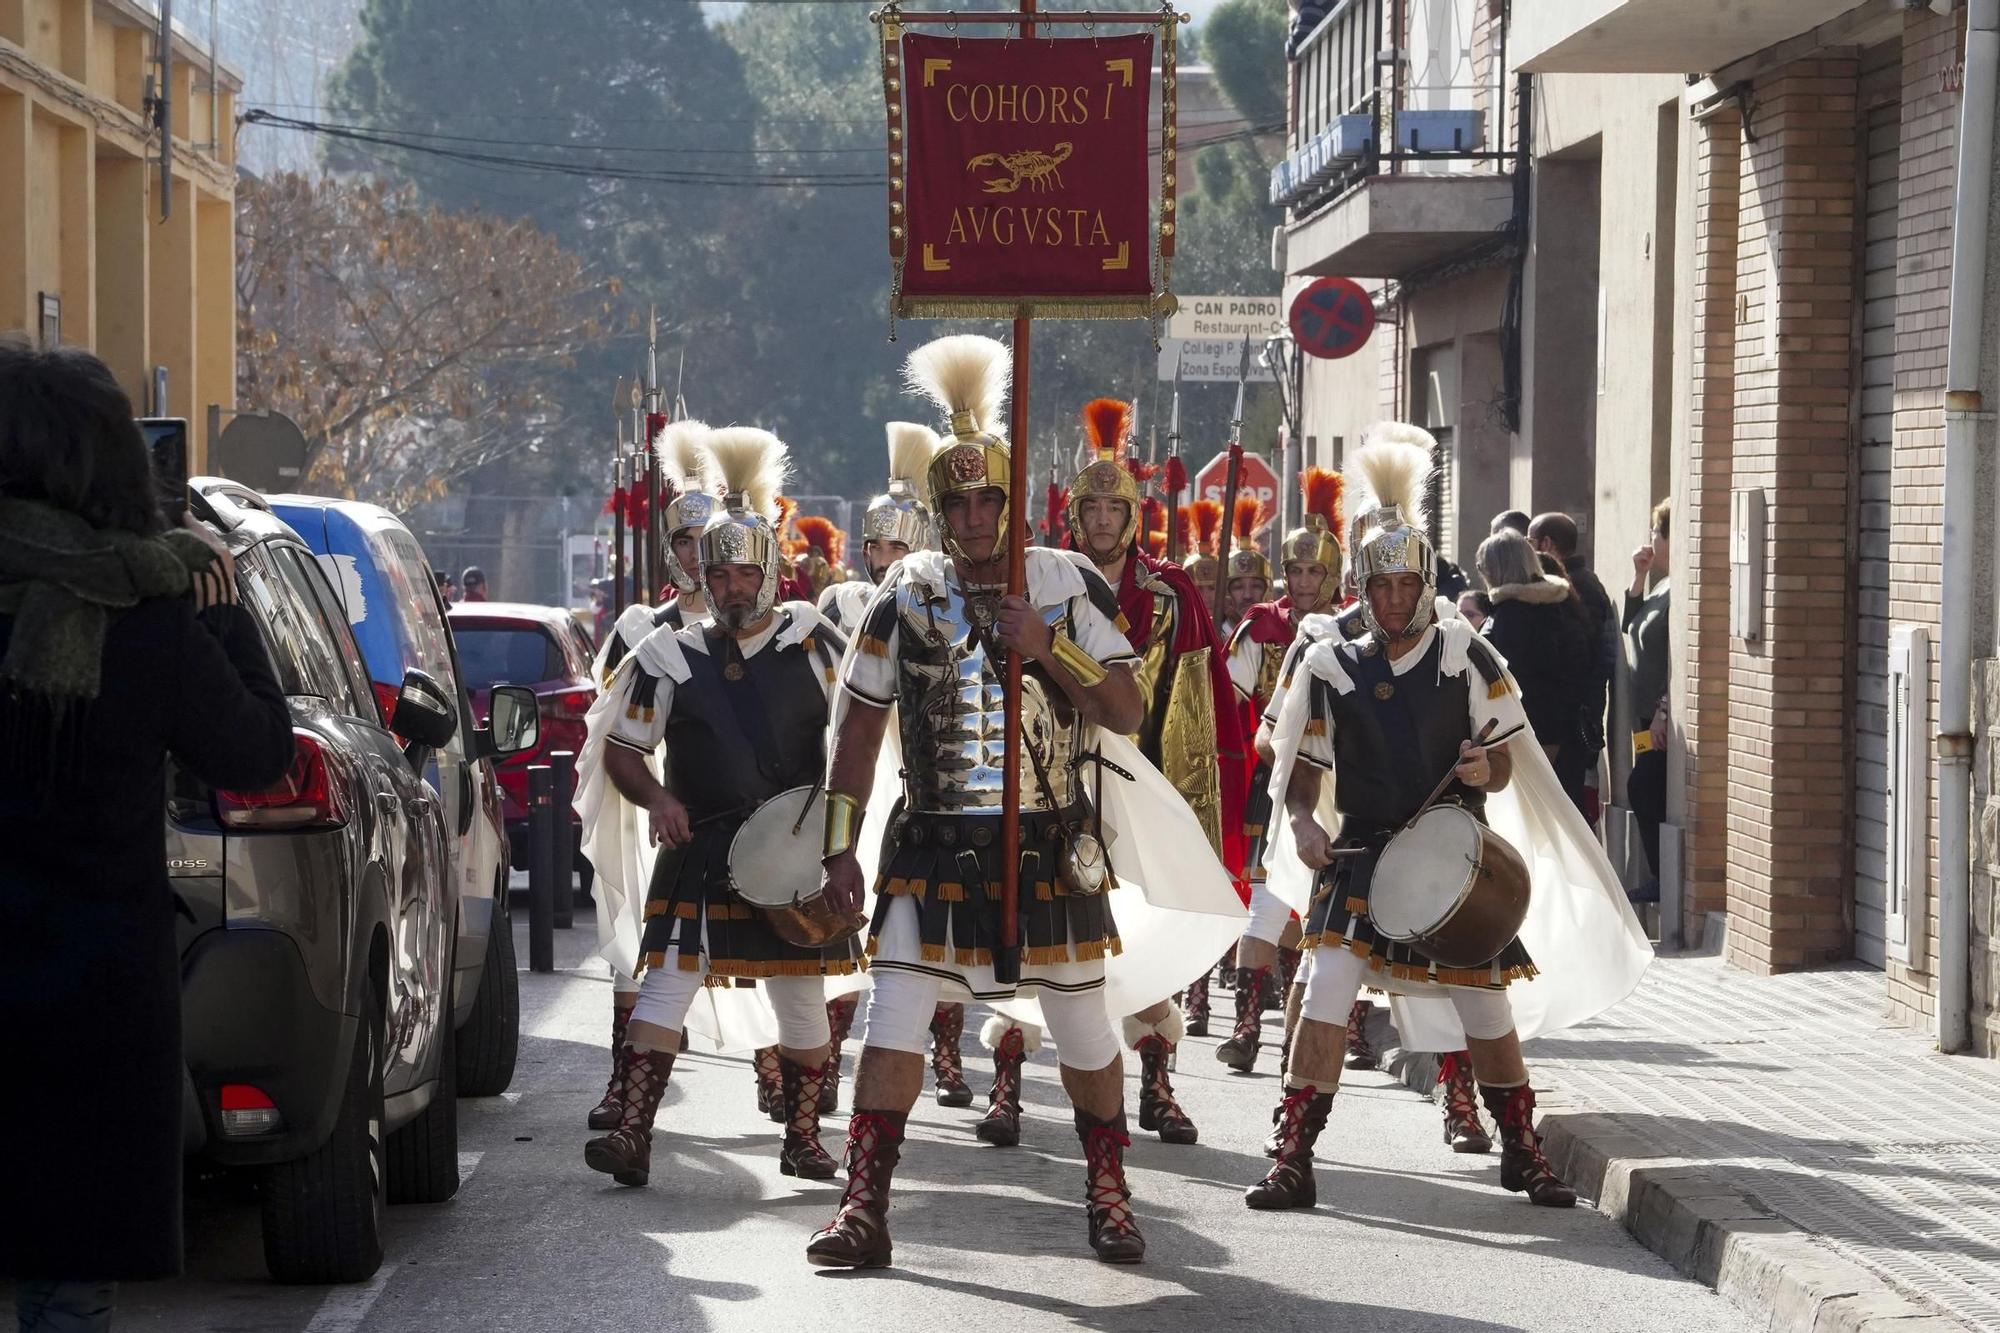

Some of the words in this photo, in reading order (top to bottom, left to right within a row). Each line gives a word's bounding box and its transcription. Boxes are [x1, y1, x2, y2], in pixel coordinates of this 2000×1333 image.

[946, 83, 1089, 125] COHORS
[1103, 82, 1113, 120] I
[944, 206, 1112, 246] AVGVSTA
[1194, 302, 1223, 315] CAN
[1230, 302, 1277, 316] PADRO
[1182, 362, 1209, 376] Zona
[1205, 484, 1273, 510] SP
[167, 859, 207, 868] OSS
